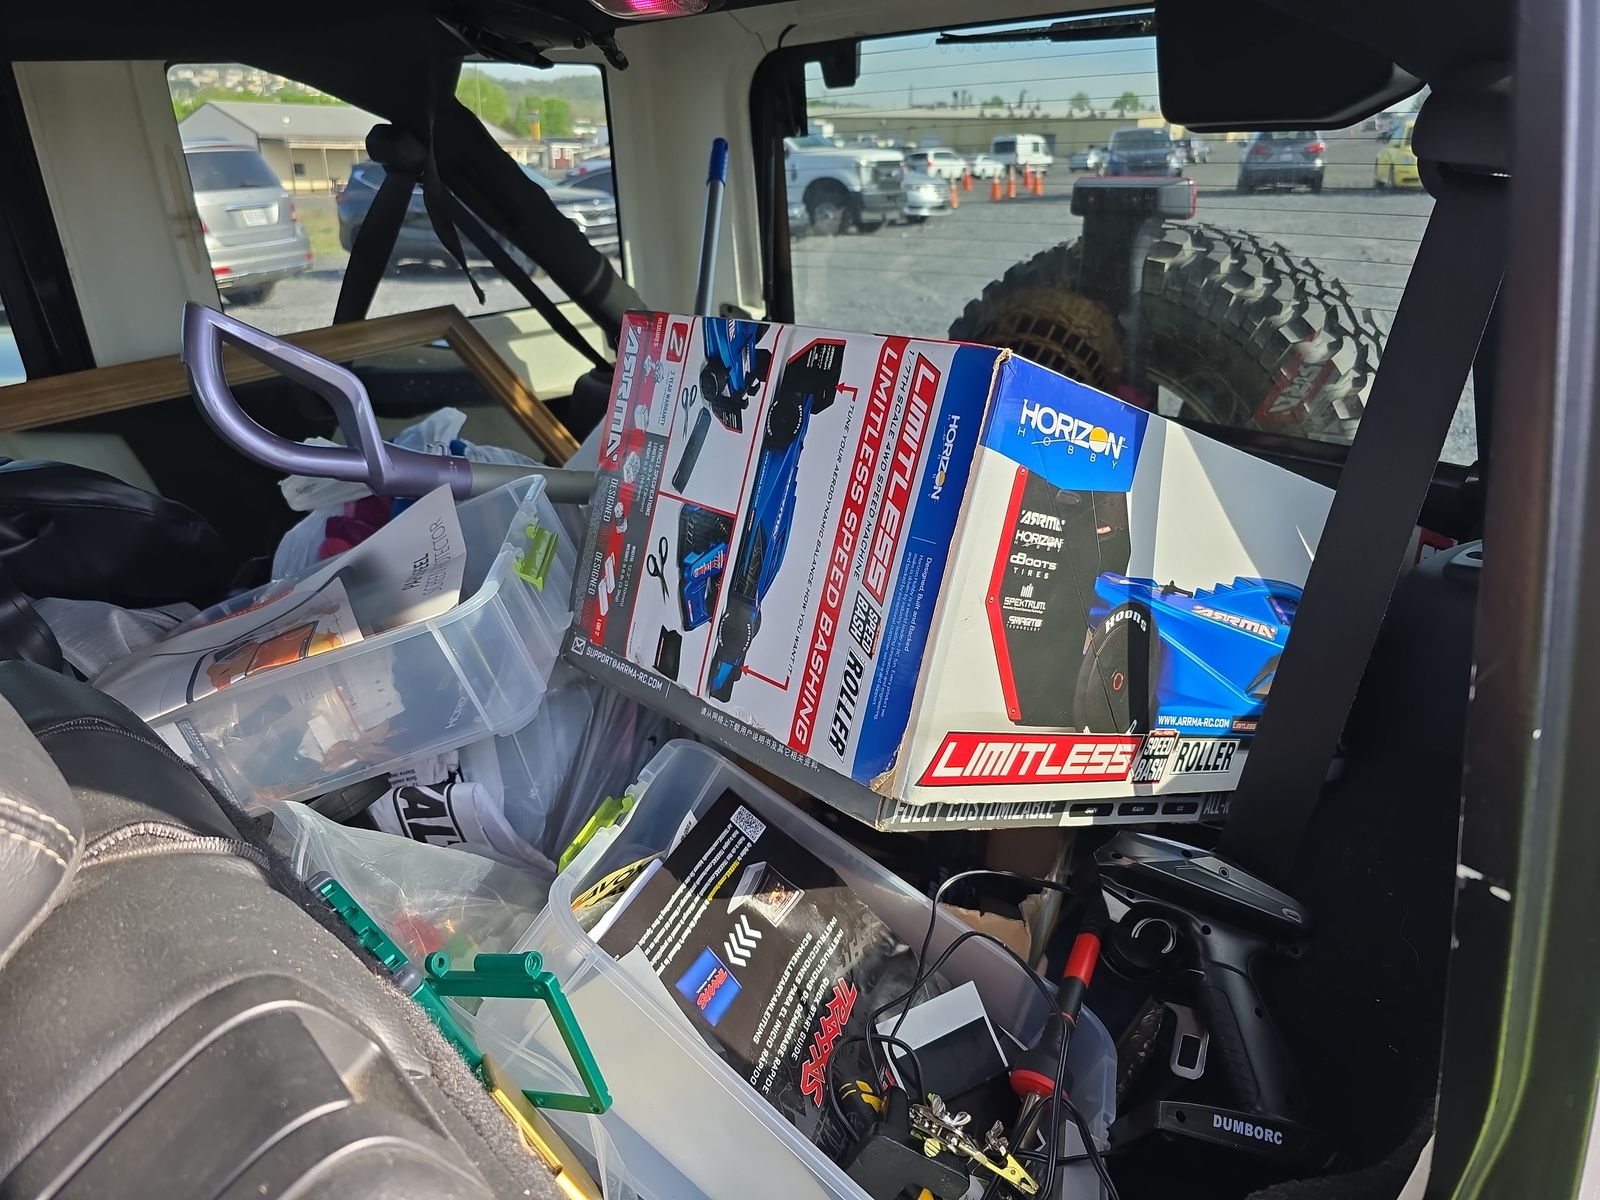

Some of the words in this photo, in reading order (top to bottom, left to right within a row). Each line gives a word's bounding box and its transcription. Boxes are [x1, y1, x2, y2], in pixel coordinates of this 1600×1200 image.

[669, 329, 685, 356] 2
[899, 349, 914, 392] 1/7TH
[659, 393, 670, 426] WARRANTY
[843, 404, 854, 433] TUNE
[888, 394, 903, 439] SCALE
[849, 346, 897, 505] LIMITLESS
[1020, 399, 1124, 459] HORIZON
[655, 444, 663, 468] VEHICLE
[835, 434, 847, 463] YOUR
[879, 440, 891, 471] 4WD
[929, 414, 959, 501] HORIZON
[866, 363, 934, 591] LIMITLESS
[602, 478, 618, 522] DESIGNED
[645, 469, 658, 516] SPECIFICATIONS
[817, 463, 839, 538] AERODYNAMIC
[867, 473, 883, 518] SPEED
[852, 519, 871, 580] MACHINE
[1015, 530, 1064, 549] HORIZON
[805, 539, 822, 588] BALANCE
[824, 506, 858, 608] SPEED
[914, 554, 923, 578] Horizon
[587, 551, 602, 595] DESIGNED
[901, 563, 910, 584] backed
[909, 577, 918, 596] Hobby
[918, 556, 932, 592] Designed,
[1013, 567, 1049, 579] TIRES
[800, 588, 810, 612] HOW
[891, 592, 903, 624] exceptional
[914, 593, 923, 610] Built
[795, 613, 804, 634] YOU
[848, 595, 868, 642] BASH
[860, 608, 878, 653] SPEED
[898, 624, 906, 641] leader
[910, 611, 918, 624] and
[788, 635, 799, 663] WANT
[884, 624, 894, 651] customer
[895, 648, 900, 657] RC
[903, 625, 914, 651] Backed
[584, 646, 664, 691] SUPPORT@ARRMA-RC.COM
[786, 665, 792, 675] IT
[880, 651, 888, 671] service
[795, 610, 833, 744] BASHING
[887, 669, 895, 686] Every
[827, 651, 864, 756] ROLLER
[882, 686, 891, 708] product
[1158, 715, 1230, 729] WWW.ARRMA-RC.COM
[931, 742, 1136, 777] LIMITLESS
[1144, 737, 1175, 756] SPEED
[1173, 742, 1238, 773] ROLLER
[1134, 758, 1168, 781] BASH
[945, 801, 1057, 822] CUSTOMIZABLE
[793, 915, 836, 984] INSTRUCCIONES
[805, 928, 843, 991] INSTRUCTIONS
[752, 932, 812, 1044] SCHNELLSTART-ANLEITUNG
[783, 983, 797, 1006] PARA
[800, 990, 809, 1003] DE
[813, 976, 830, 1004] QUICK
[777, 1006, 787, 1019] EL
[801, 1004, 816, 1032] START
[764, 1018, 781, 1048] INICIO
[776, 1003, 804, 1057] DÉMARRAGE
[799, 975, 857, 1108] TRAXXAS
[790, 1031, 806, 1060] GUIDE
[748, 1048, 770, 1085] RÁPIDO
[761, 1057, 780, 1094] RAPIDE
[1213, 1114, 1284, 1145] DUMBORC
